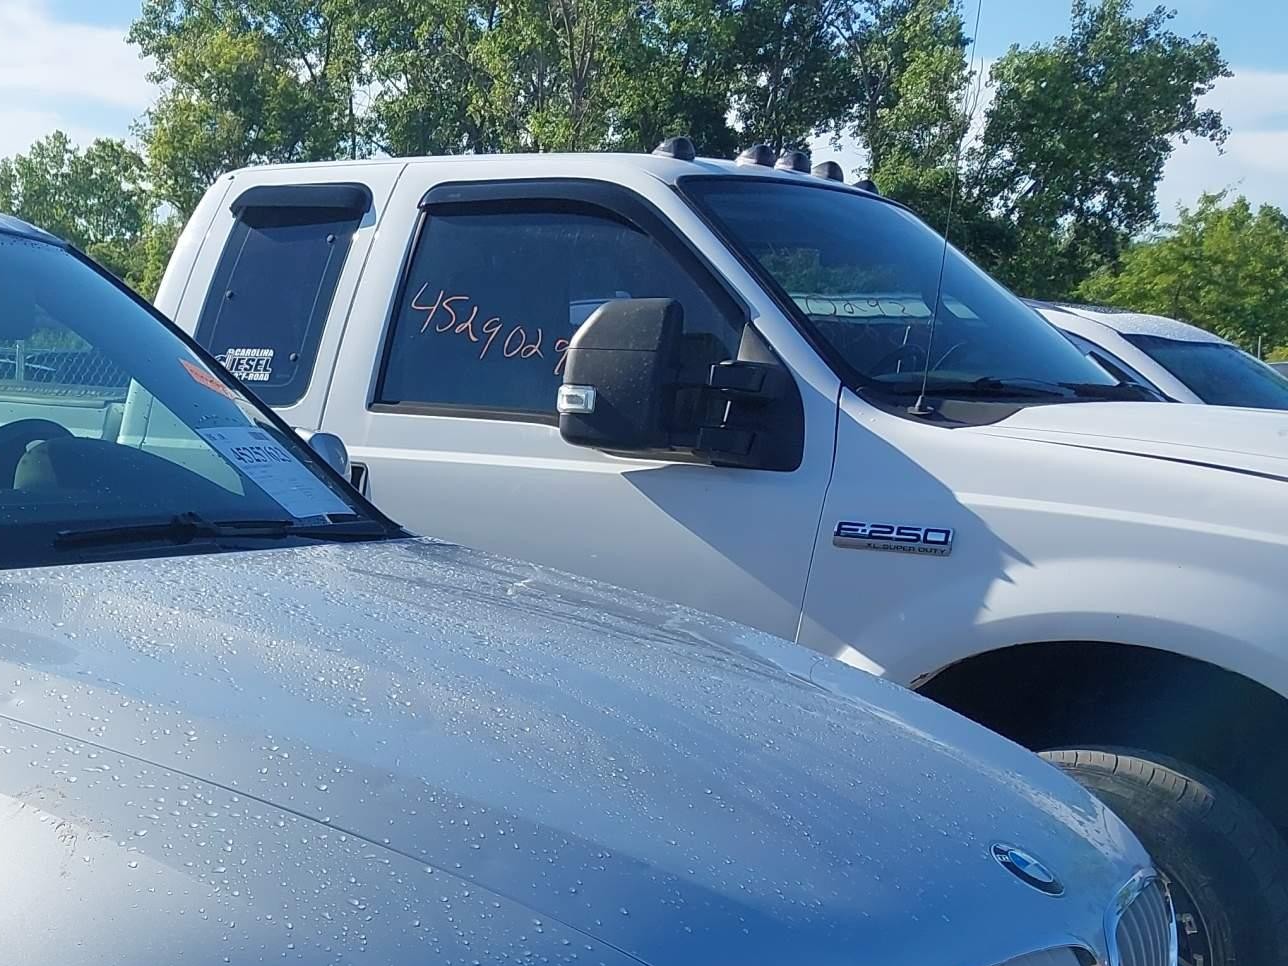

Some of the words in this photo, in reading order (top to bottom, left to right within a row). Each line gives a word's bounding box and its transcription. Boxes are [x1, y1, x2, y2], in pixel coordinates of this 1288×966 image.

[234, 348, 274, 357] CAROLINA
[833, 520, 953, 546] F-250
[880, 544, 916, 552] SUPER
[918, 546, 946, 555] DUTY
